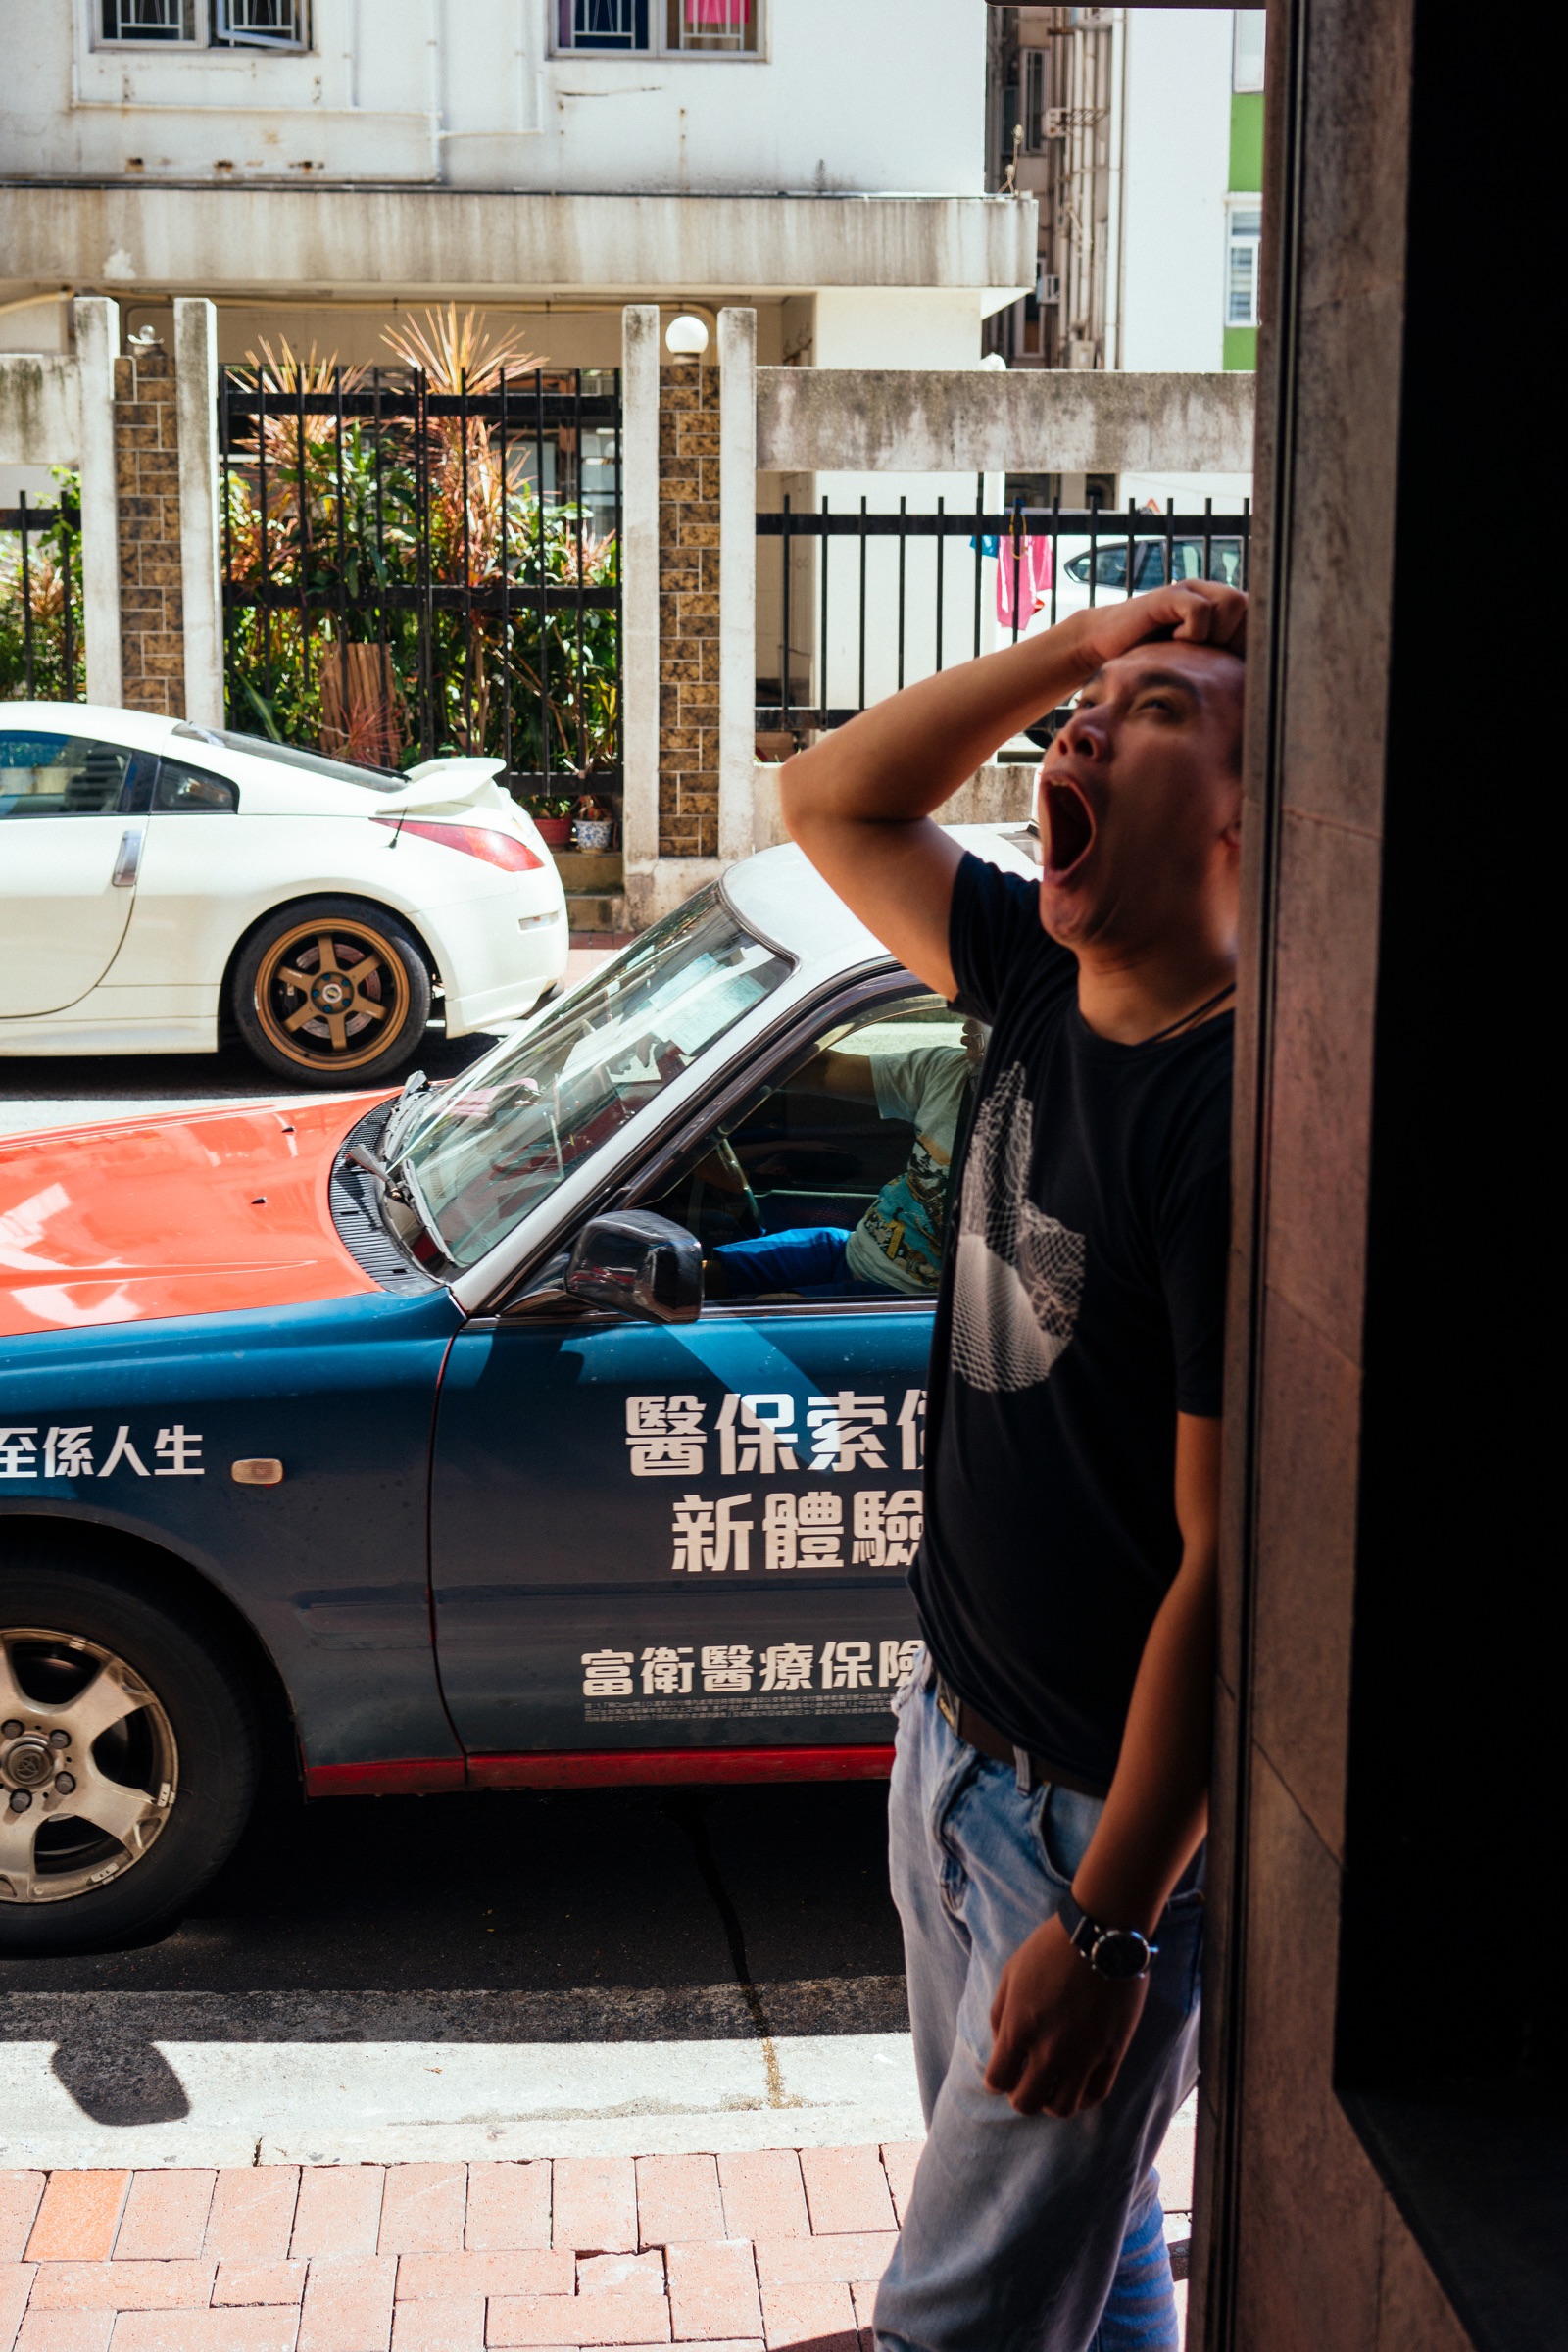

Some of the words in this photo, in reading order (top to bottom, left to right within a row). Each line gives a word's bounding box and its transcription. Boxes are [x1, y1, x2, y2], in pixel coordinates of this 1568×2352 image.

[0, 1424, 205, 1478] 至係人生
[671, 1490, 924, 1572] 新體驗
[580, 1640, 926, 1696] 富衛醫療保險
